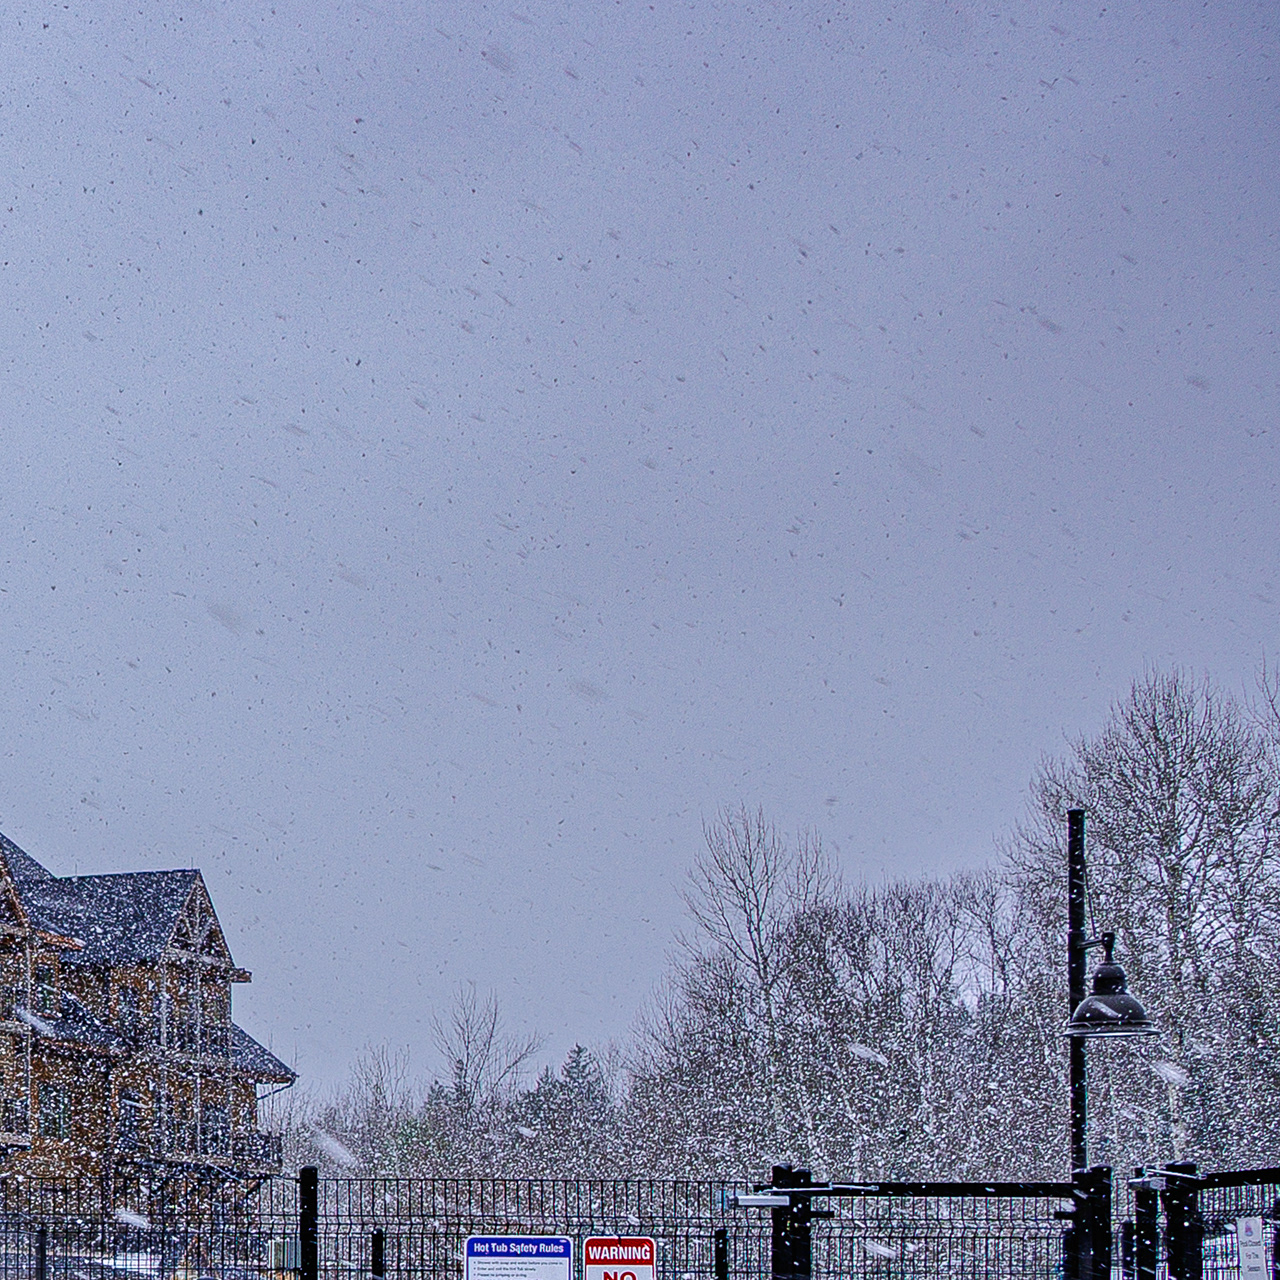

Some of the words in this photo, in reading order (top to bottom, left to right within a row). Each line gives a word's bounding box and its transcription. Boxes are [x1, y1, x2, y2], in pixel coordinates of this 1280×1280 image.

[474, 1243, 489, 1253] Hot
[491, 1243, 508, 1253] Tub
[509, 1243, 538, 1254] Safety
[539, 1243, 564, 1253] Rules
[588, 1246, 650, 1260] WARNING
